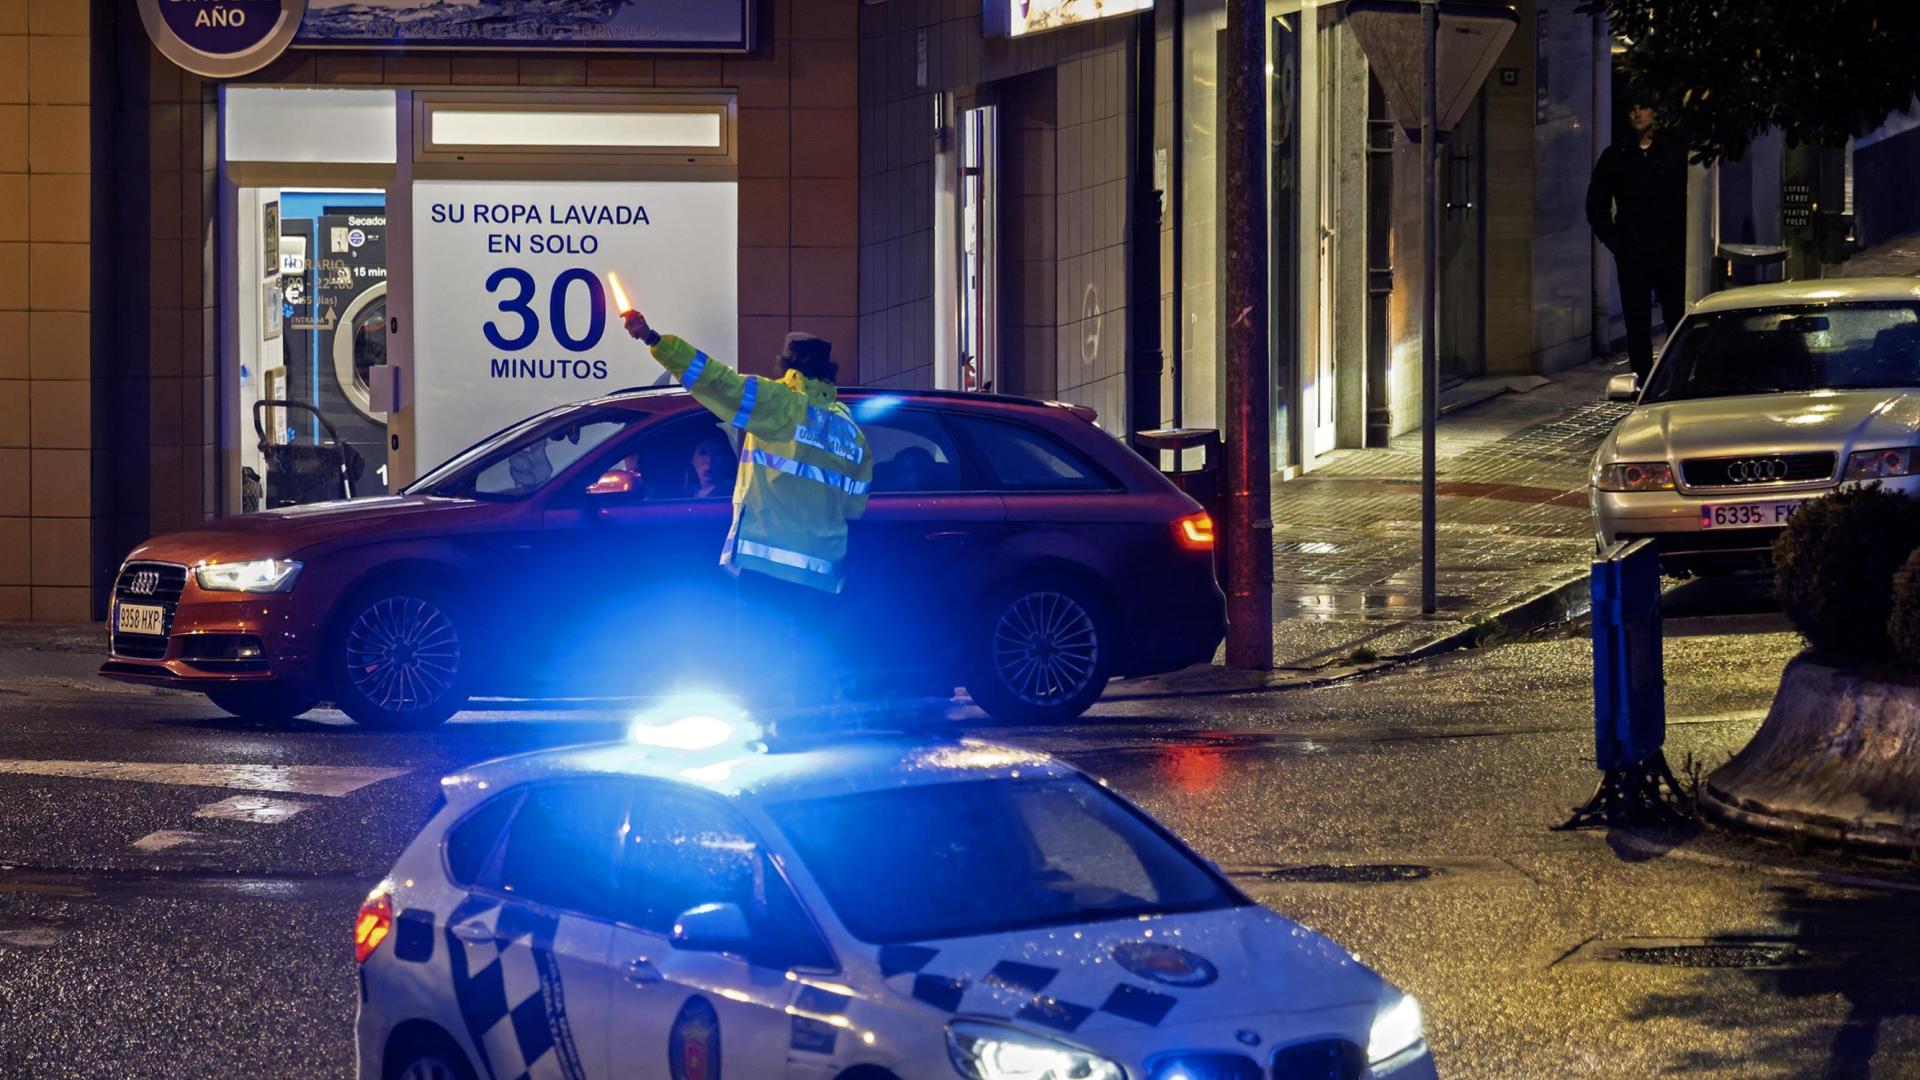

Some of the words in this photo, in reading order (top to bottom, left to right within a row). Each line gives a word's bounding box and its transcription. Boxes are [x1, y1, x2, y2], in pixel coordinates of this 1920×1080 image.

[194, 5, 246, 28] AÑO
[431, 203, 465, 224] SU
[473, 204, 542, 224] ROPA
[550, 205, 650, 226] LAVADA
[488, 234, 522, 254] EN
[529, 234, 599, 254] SOLO
[354, 267, 367, 277] 15
[291, 316, 325, 324] ENTRAA
[482, 267, 607, 353] 30
[490, 359, 608, 379] MINUTOS
[1715, 505, 1762, 525] 6335
[1775, 504, 1801, 523] FK
[121, 608, 140, 628] 9358
[142, 609, 160, 630] HXP
